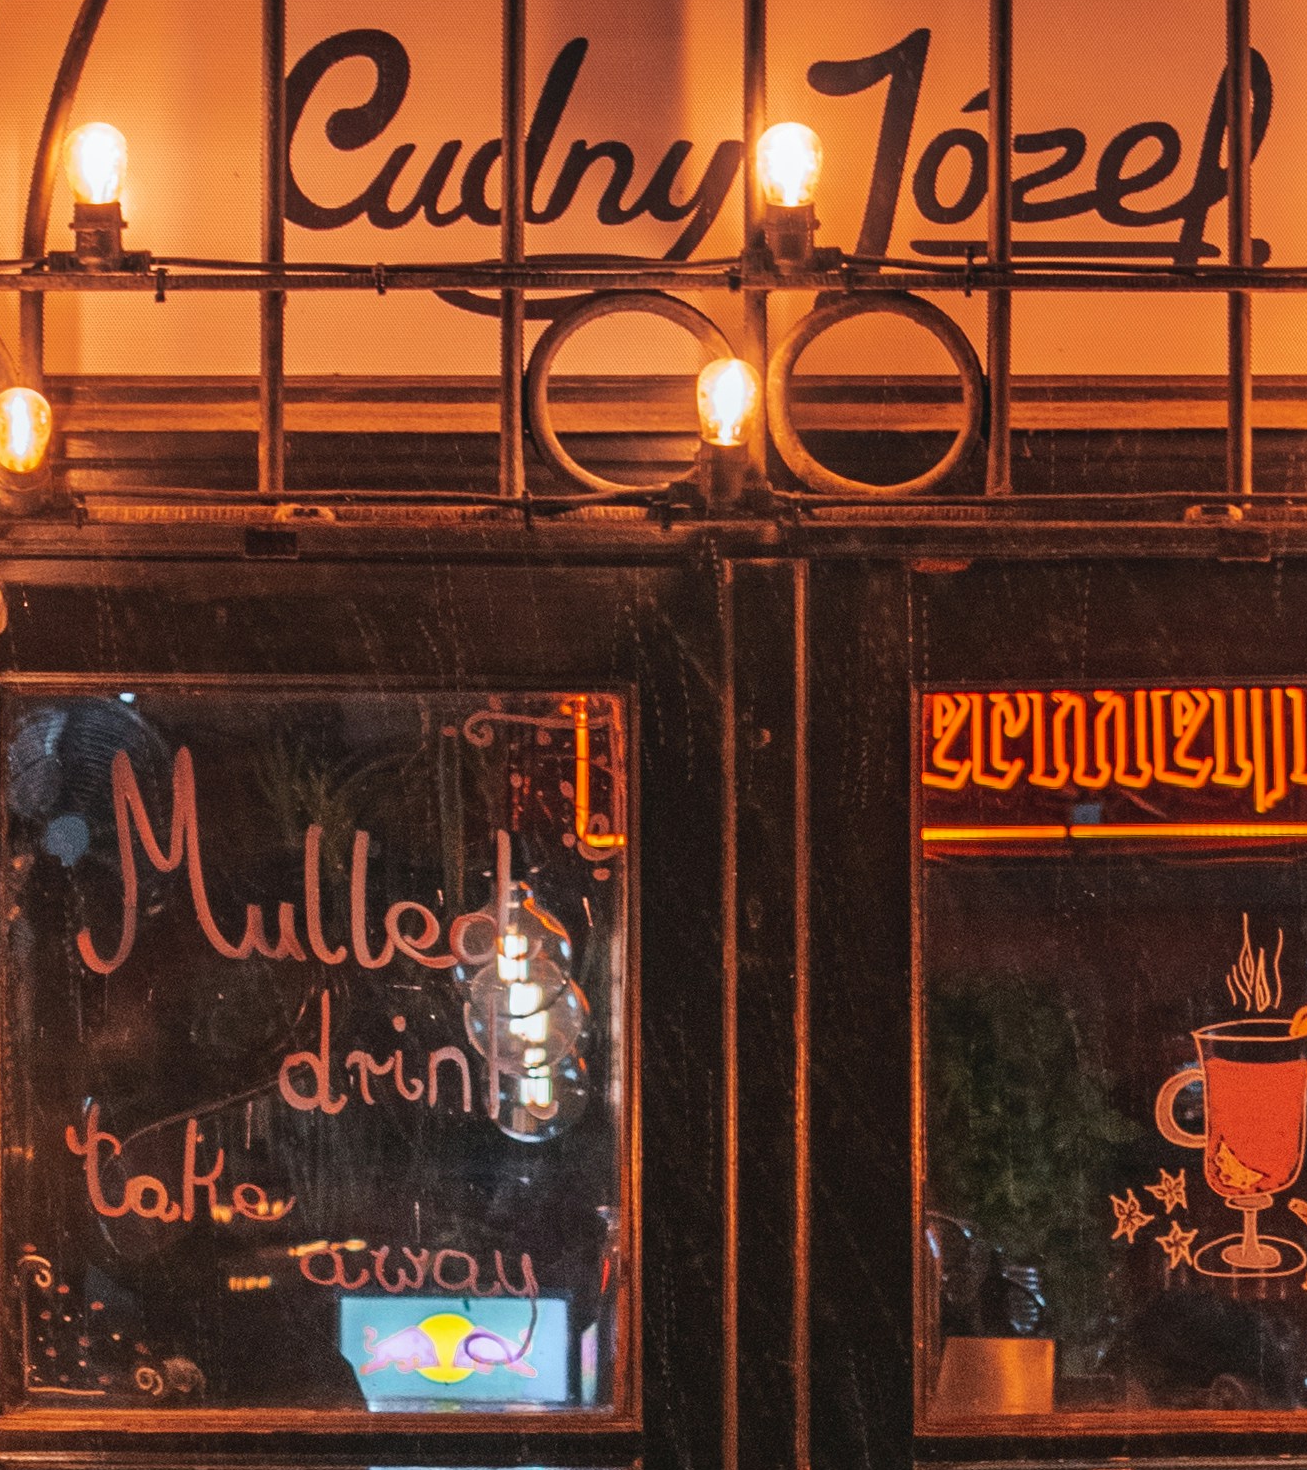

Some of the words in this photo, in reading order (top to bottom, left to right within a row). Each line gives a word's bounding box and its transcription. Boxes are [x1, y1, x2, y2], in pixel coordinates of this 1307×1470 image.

[283, 27, 744, 320] Cudny
[77, 745, 542, 975] Mulled
[299, 1242, 539, 1364] away
